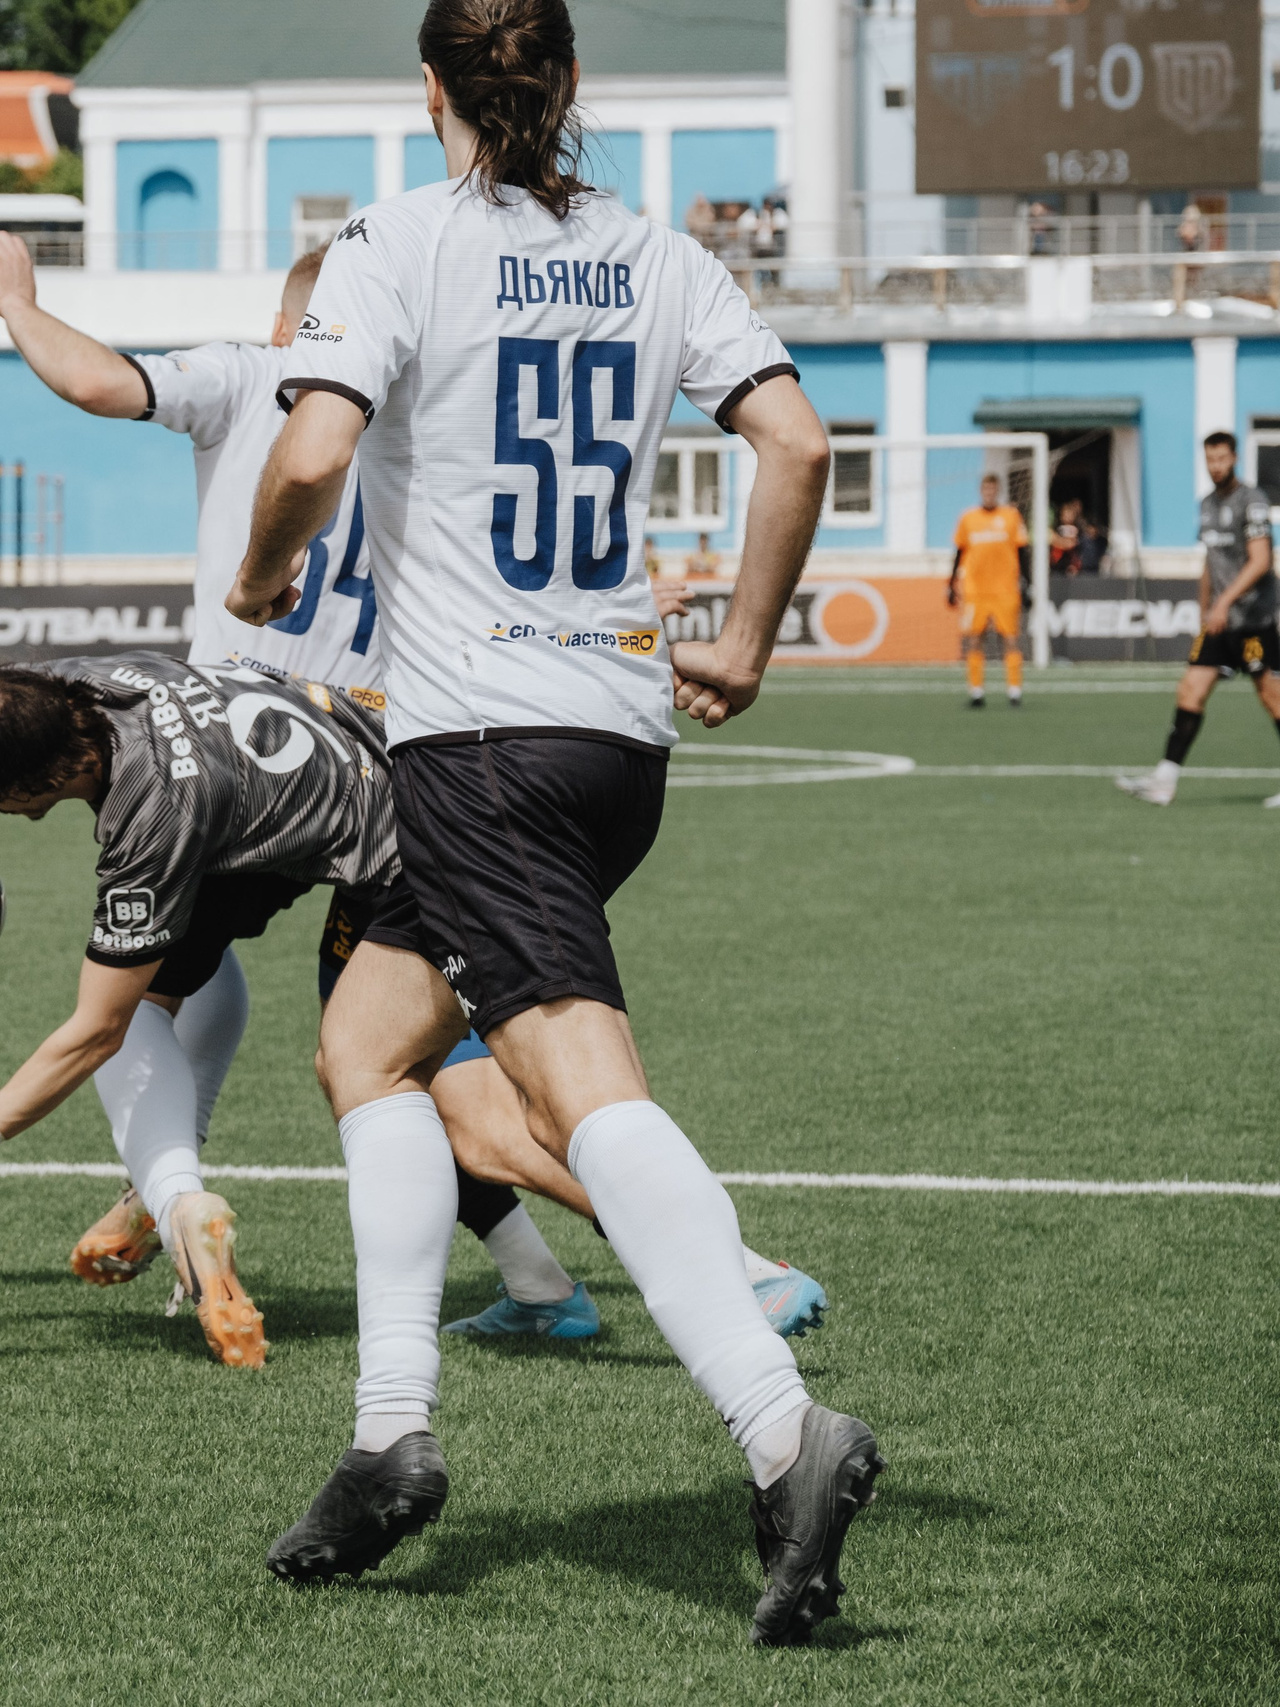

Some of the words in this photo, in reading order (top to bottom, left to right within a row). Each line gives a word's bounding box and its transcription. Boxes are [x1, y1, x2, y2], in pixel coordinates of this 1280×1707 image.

[1047, 42, 1144, 112] 1:0
[496, 255, 636, 312] ДЬЯКОВ
[490, 336, 637, 591] 55
[619, 634, 655, 651] PRO
[351, 689, 386, 707] PRO
[115, 901, 148, 921] BB
